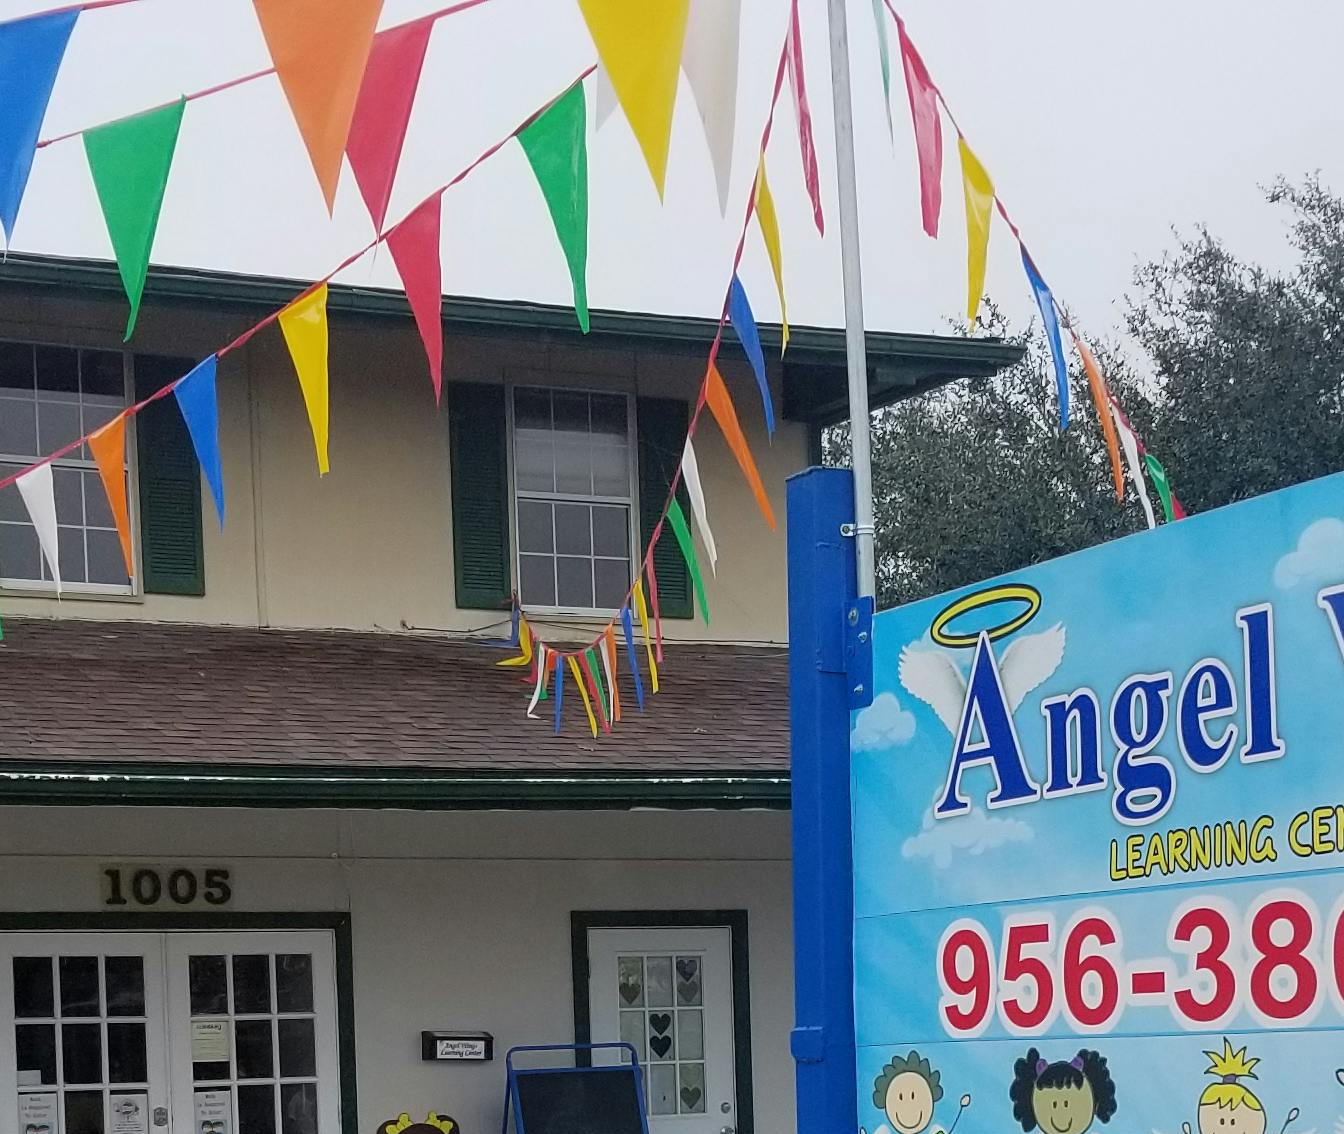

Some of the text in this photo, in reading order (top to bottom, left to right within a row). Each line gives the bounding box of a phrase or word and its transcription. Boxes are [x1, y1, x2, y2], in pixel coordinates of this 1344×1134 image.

[934, 606, 1283, 822] Angel
[1108, 815, 1278, 882] LEARNING
[104, 868, 232, 905] 1005
